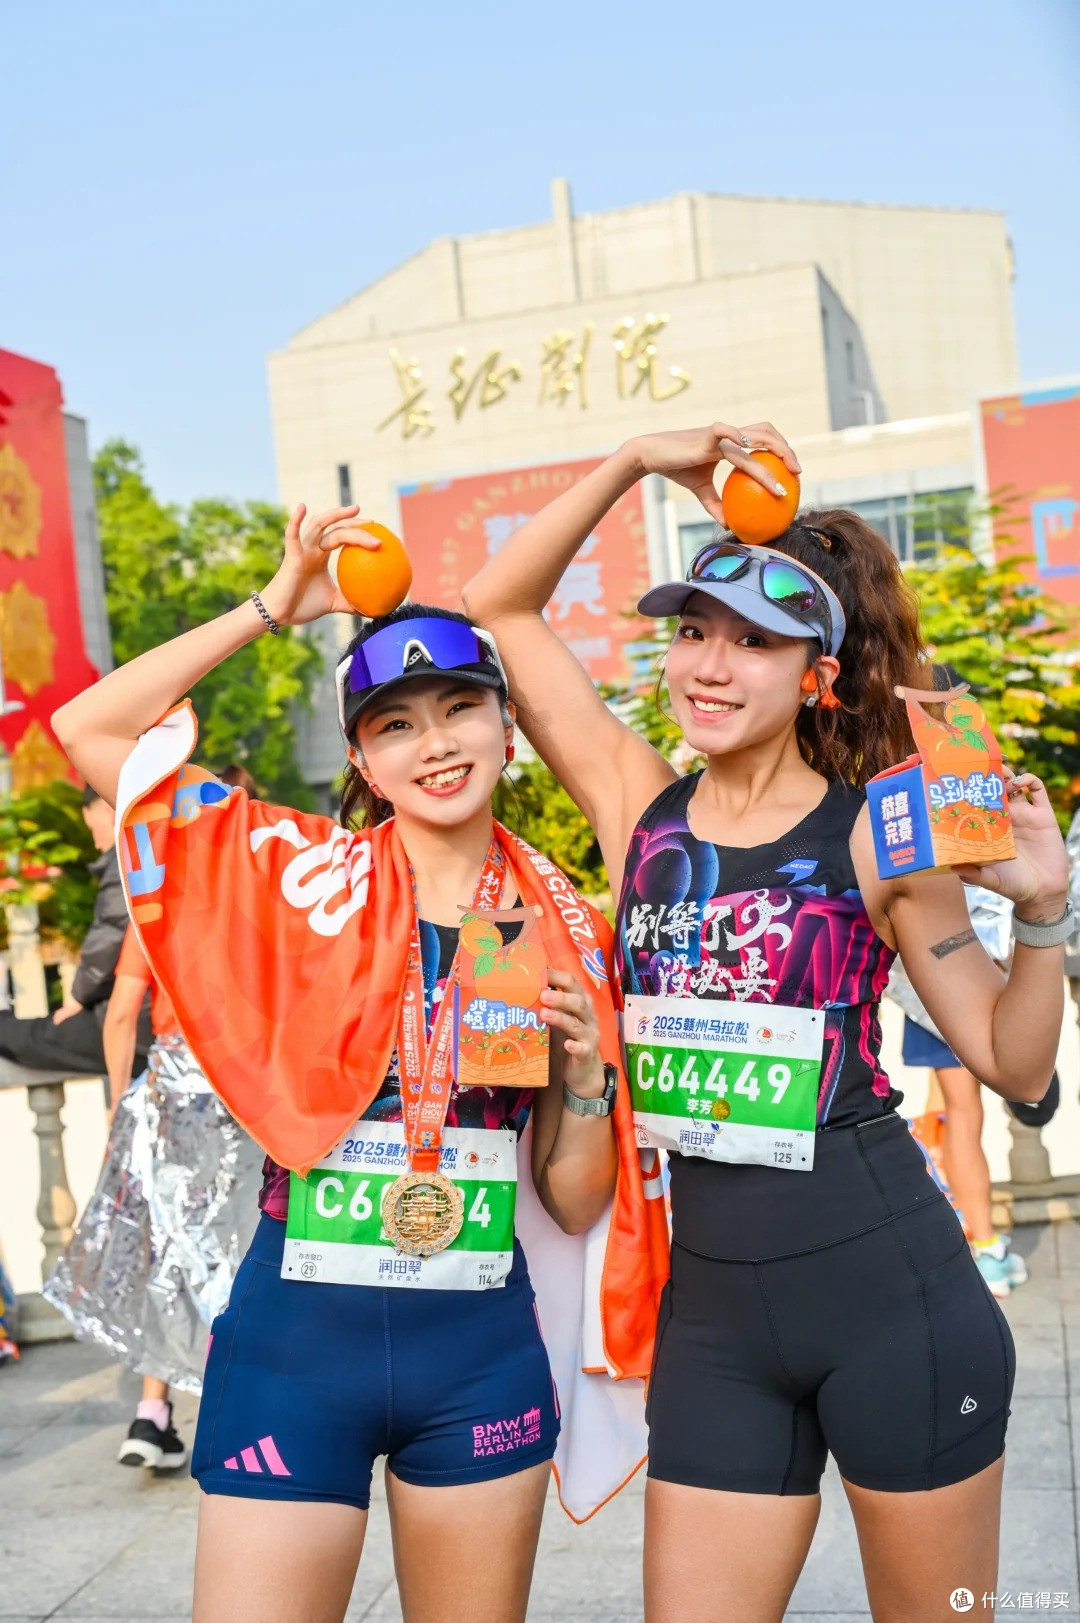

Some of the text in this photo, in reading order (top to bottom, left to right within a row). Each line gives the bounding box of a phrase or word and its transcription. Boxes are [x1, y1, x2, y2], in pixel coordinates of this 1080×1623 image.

[881, 791, 909, 822] 恭喜
[884, 818, 913, 847] 完赛
[653, 1015, 749, 1036] 2025赣州马拉松
[403, 1005, 416, 1078] 2025赣州马拉松
[653, 1030, 667, 1038] 2025
[667, 1031, 701, 1041] GANZHOU
[703, 1033, 748, 1044] MARATHON
[636, 1051, 792, 1105] C64449
[421, 1108, 442, 1117] ZHOU
[424, 1101, 442, 1110] GAN
[687, 1098, 713, 1115] 李芳
[679, 1129, 717, 1147] 润田翠
[342, 1155, 406, 1167] 2025 GANZHOU
[773, 1152, 792, 1164] 125
[304, 1264, 314, 1275] 29
[378, 1259, 422, 1275] 润田翠
[478, 1275, 492, 1285] 114
[473, 1416, 520, 1438] BMW
[473, 1431, 541, 1458] MARATHON
[474, 1429, 521, 1448] BERLIN
